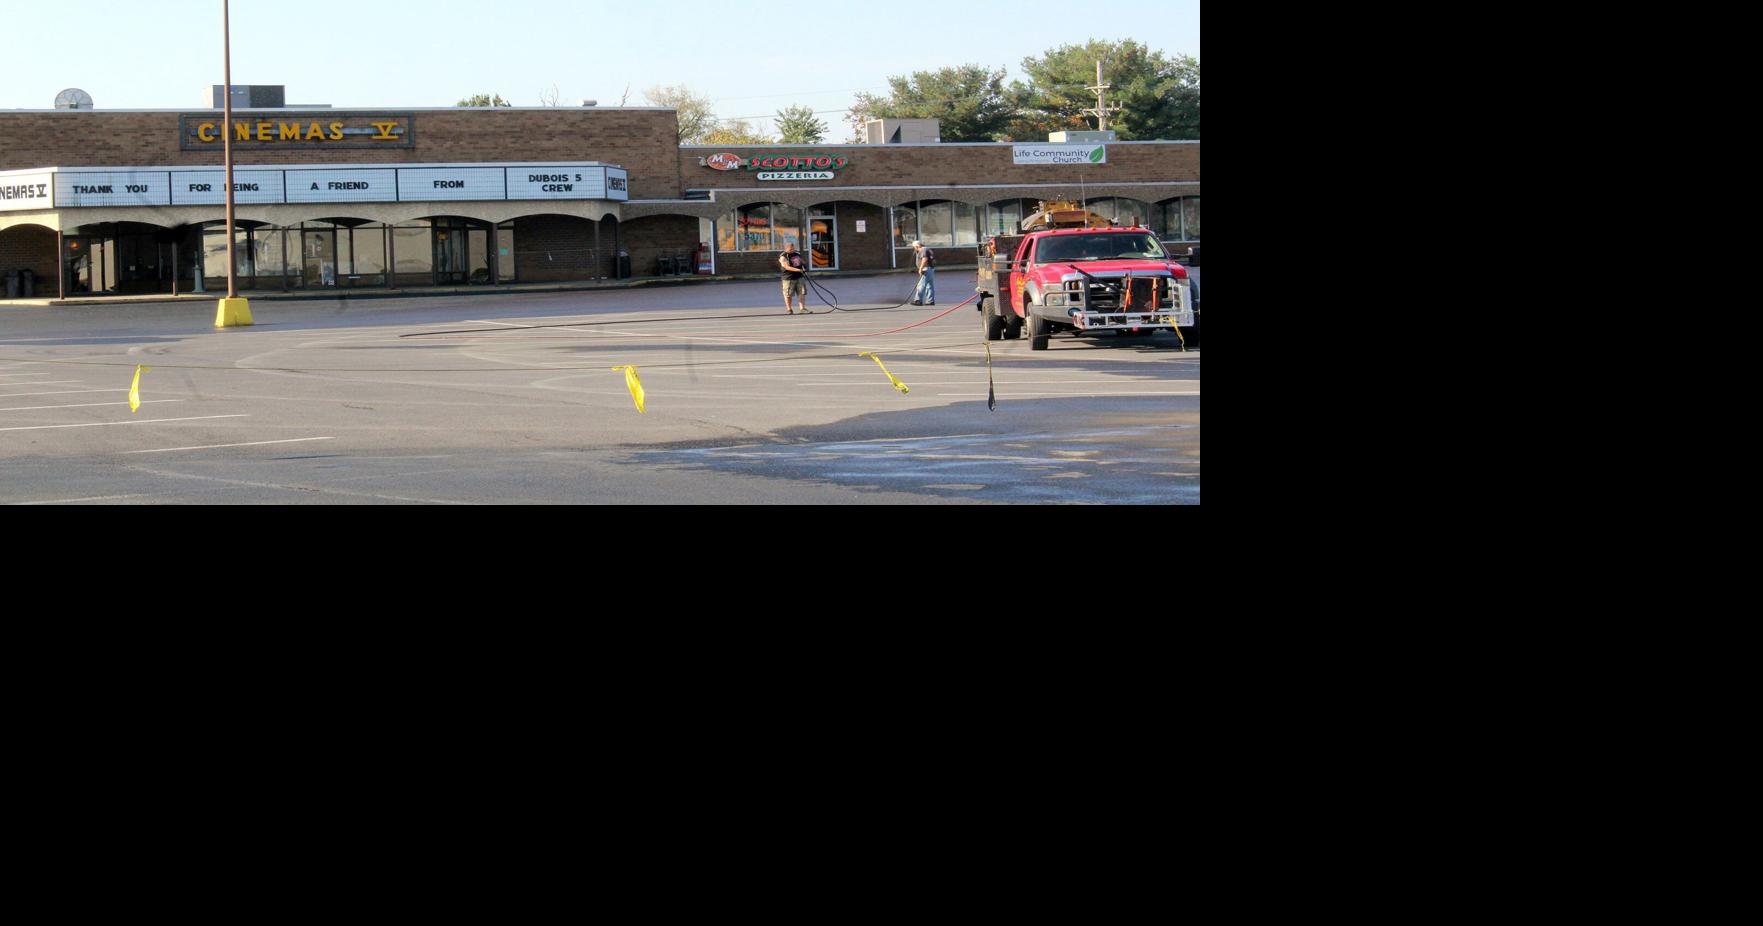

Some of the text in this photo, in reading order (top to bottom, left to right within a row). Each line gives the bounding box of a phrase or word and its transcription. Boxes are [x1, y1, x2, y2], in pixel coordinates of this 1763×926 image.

[198, 122, 399, 142] CINEMAS V
[1033, 149, 1089, 158] Community
[750, 156, 847, 168] SCOTTO'S
[528, 173, 582, 183] DUBOIS 5
[36, 184, 47, 198] V
[72, 185, 114, 194] THANK
[124, 185, 148, 193] YOU
[189, 183, 212, 193] FOR
[310, 182, 319, 191] A
[328, 181, 369, 191] FRIEND
[433, 180, 465, 189] FROM
[541, 184, 574, 192] CREW
